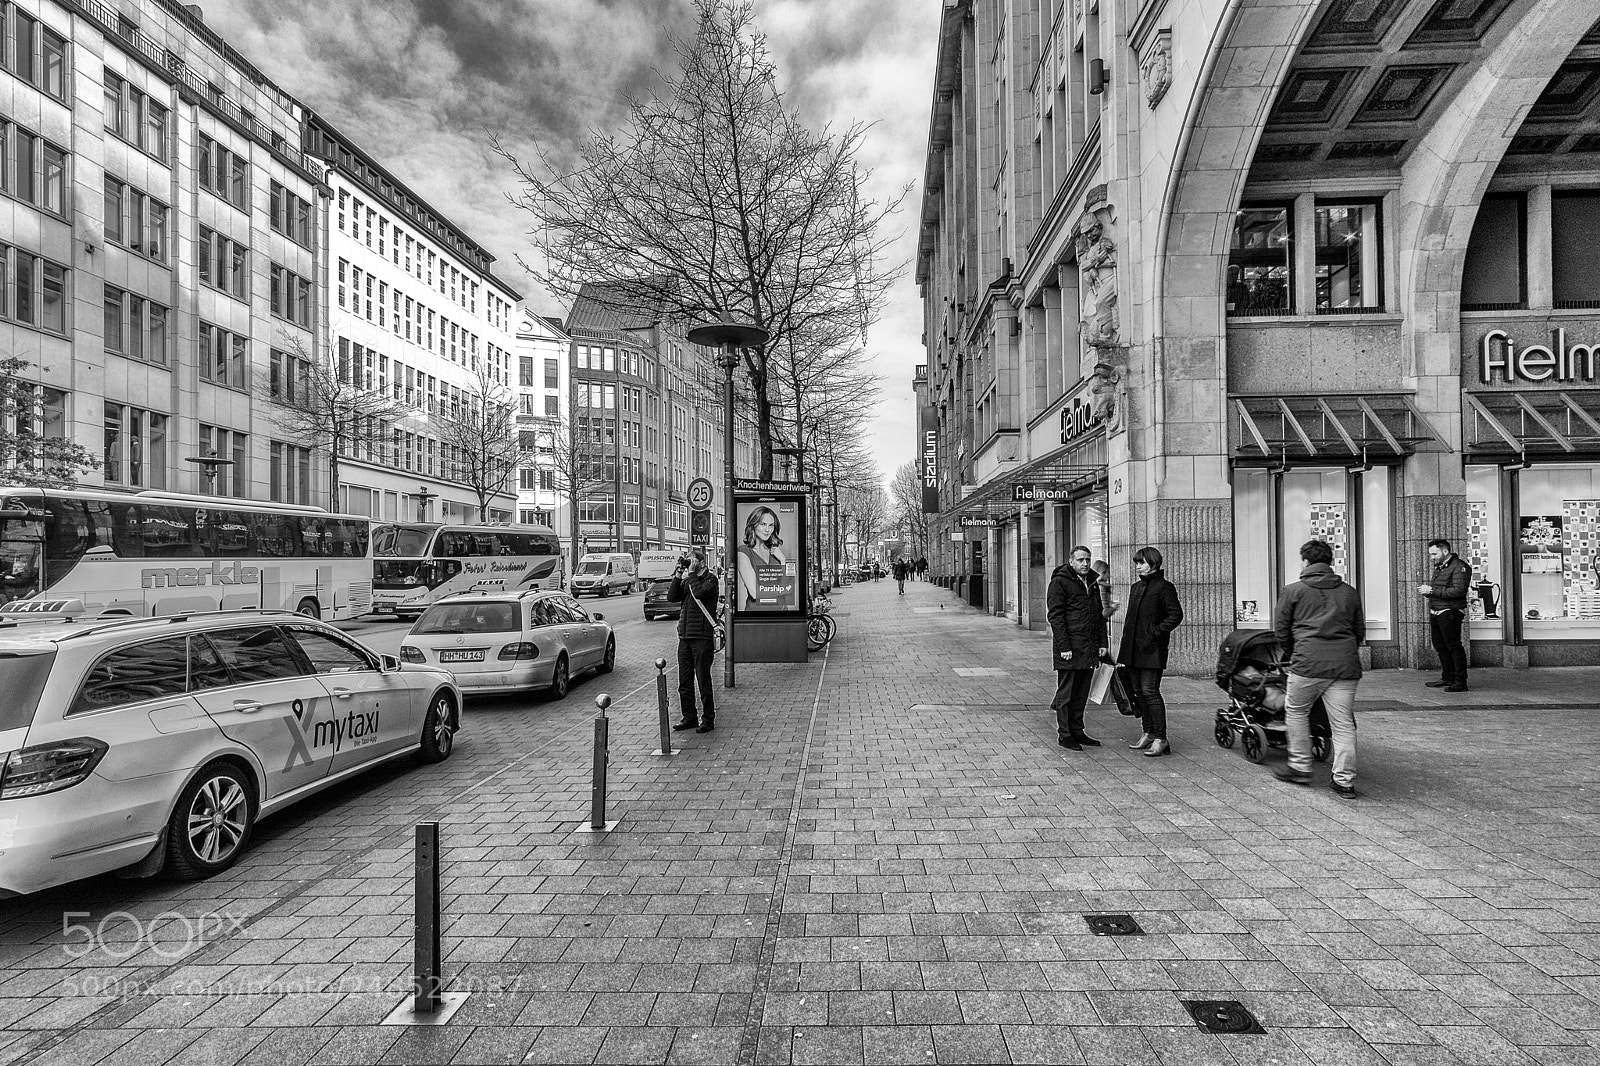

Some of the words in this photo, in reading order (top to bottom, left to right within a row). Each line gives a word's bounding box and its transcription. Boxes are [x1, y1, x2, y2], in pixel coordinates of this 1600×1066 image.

[924, 430, 937, 488] stadium
[1114, 478, 1122, 494] 29
[693, 487, 708, 501] 25
[692, 534, 709, 543] TAXI
[141, 561, 259, 589] merkle
[759, 584, 785, 594] Parship
[10, 601, 59, 612] TAXI
[313, 702, 380, 752] mytaxi
